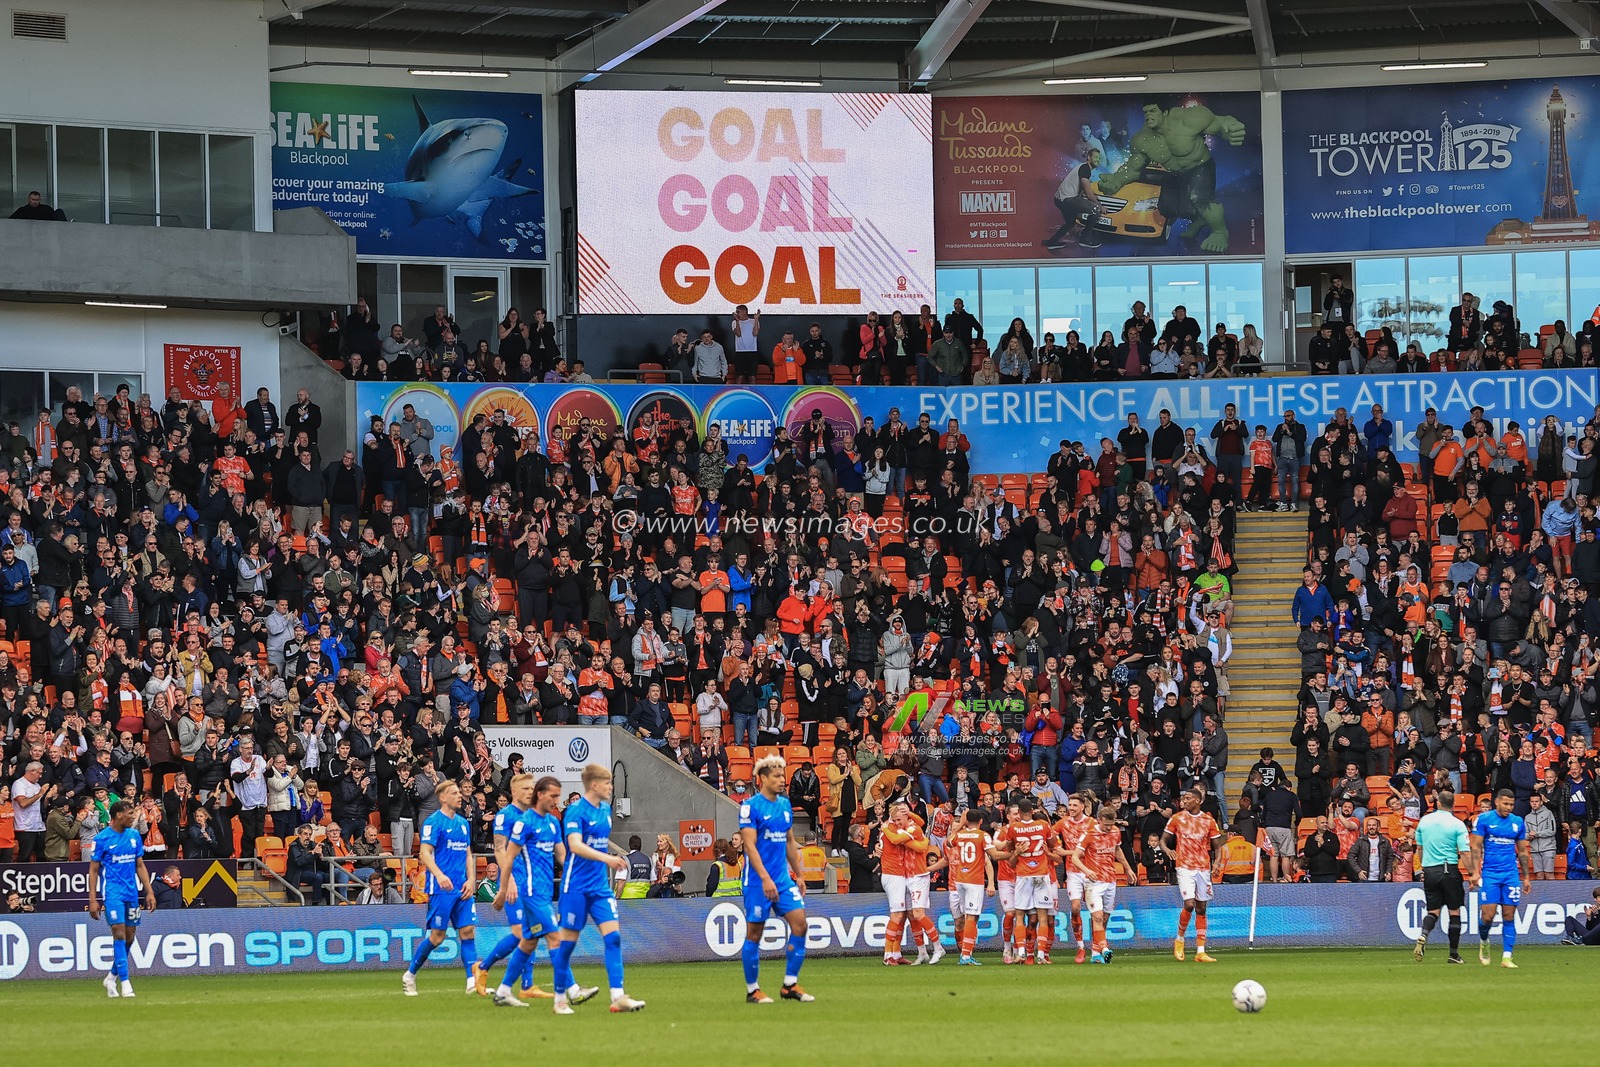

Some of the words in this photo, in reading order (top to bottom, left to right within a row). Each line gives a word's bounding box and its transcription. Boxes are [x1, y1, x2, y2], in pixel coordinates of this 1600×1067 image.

[939, 107, 1034, 134] Madame
[657, 106, 846, 163] GOAL
[1309, 134, 1337, 147] THE
[1340, 129, 1433, 146] BLACKPOOL
[1460, 128, 1502, 138] 1894-2019
[939, 133, 1032, 160] Tussauds
[290, 151, 349, 166] Blackpool
[1309, 143, 1437, 177] TOWER
[1456, 140, 1514, 170] 125
[953, 165, 1025, 174] BLACKPOOL
[307, 179, 333, 191] your
[336, 179, 385, 194] amazing
[1448, 183, 1486, 192] #Tower125
[272, 188, 330, 202] adventure
[332, 191, 369, 206] today!
[657, 173, 853, 233] GOAL
[961, 192, 1014, 213] MARVEL
[1310, 202, 1513, 221] www.theblackpooltower.com
[658, 244, 862, 305] GOAL
[183, 349, 222, 371] BLACKPOOL
[185, 380, 209, 397] FOOTBALL
[919, 387, 1136, 426] EXPERIENCE
[1147, 386, 1220, 420] ALL
[1227, 382, 1340, 418] THESE
[1350, 374, 1598, 414] ATTRACTION
[727, 437, 757, 446] Blackpool
[498, 737, 555, 750] Volkswagen
[546, 765, 555, 773] FC
[1014, 824, 1044, 834] HAMILTON
[958, 841, 976, 864] 10
[38, 923, 236, 972] eleven
[244, 928, 458, 967] SPORTS
